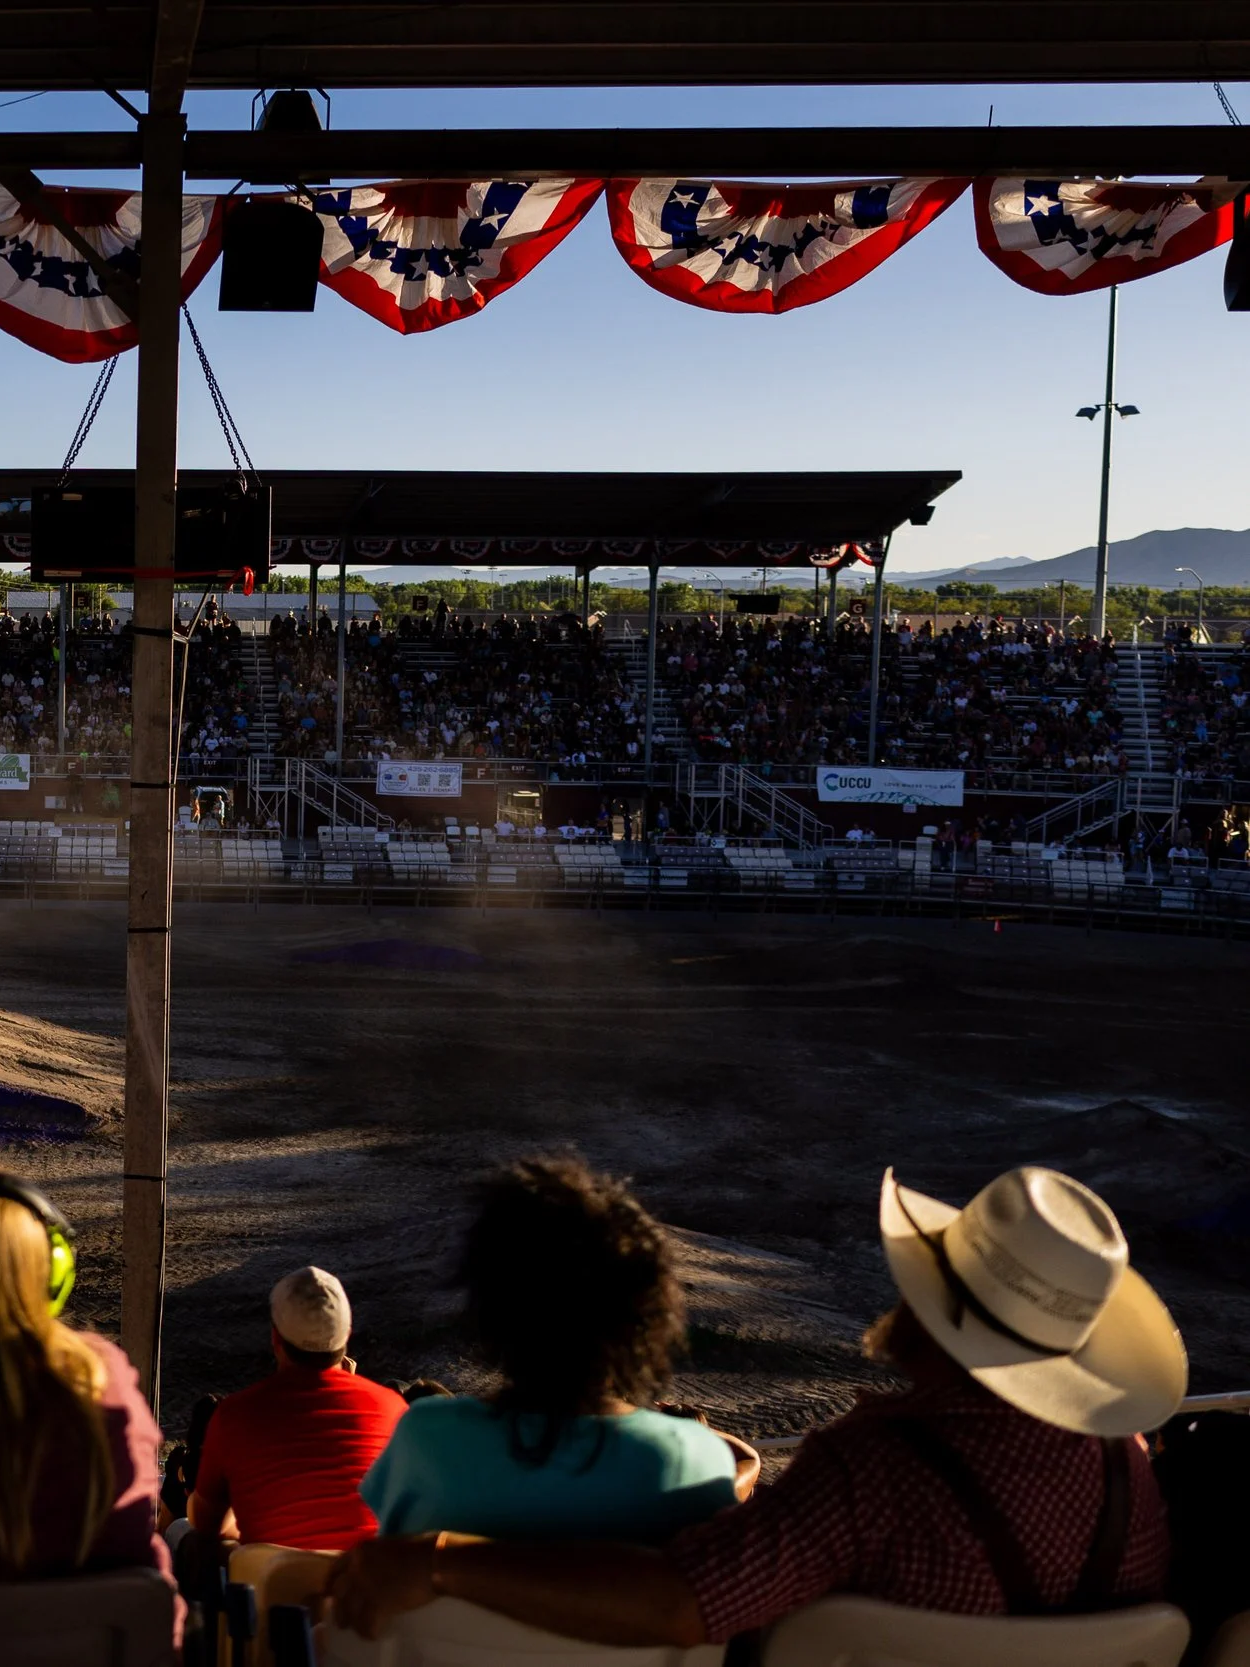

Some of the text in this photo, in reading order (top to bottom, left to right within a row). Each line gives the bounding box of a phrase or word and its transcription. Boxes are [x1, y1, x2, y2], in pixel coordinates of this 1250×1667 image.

[77, 596, 85, 606] E
[416, 600, 425, 610] F
[852, 603, 863, 613] G
[477, 767, 487, 779] F
[839, 777, 872, 789] UCCU
